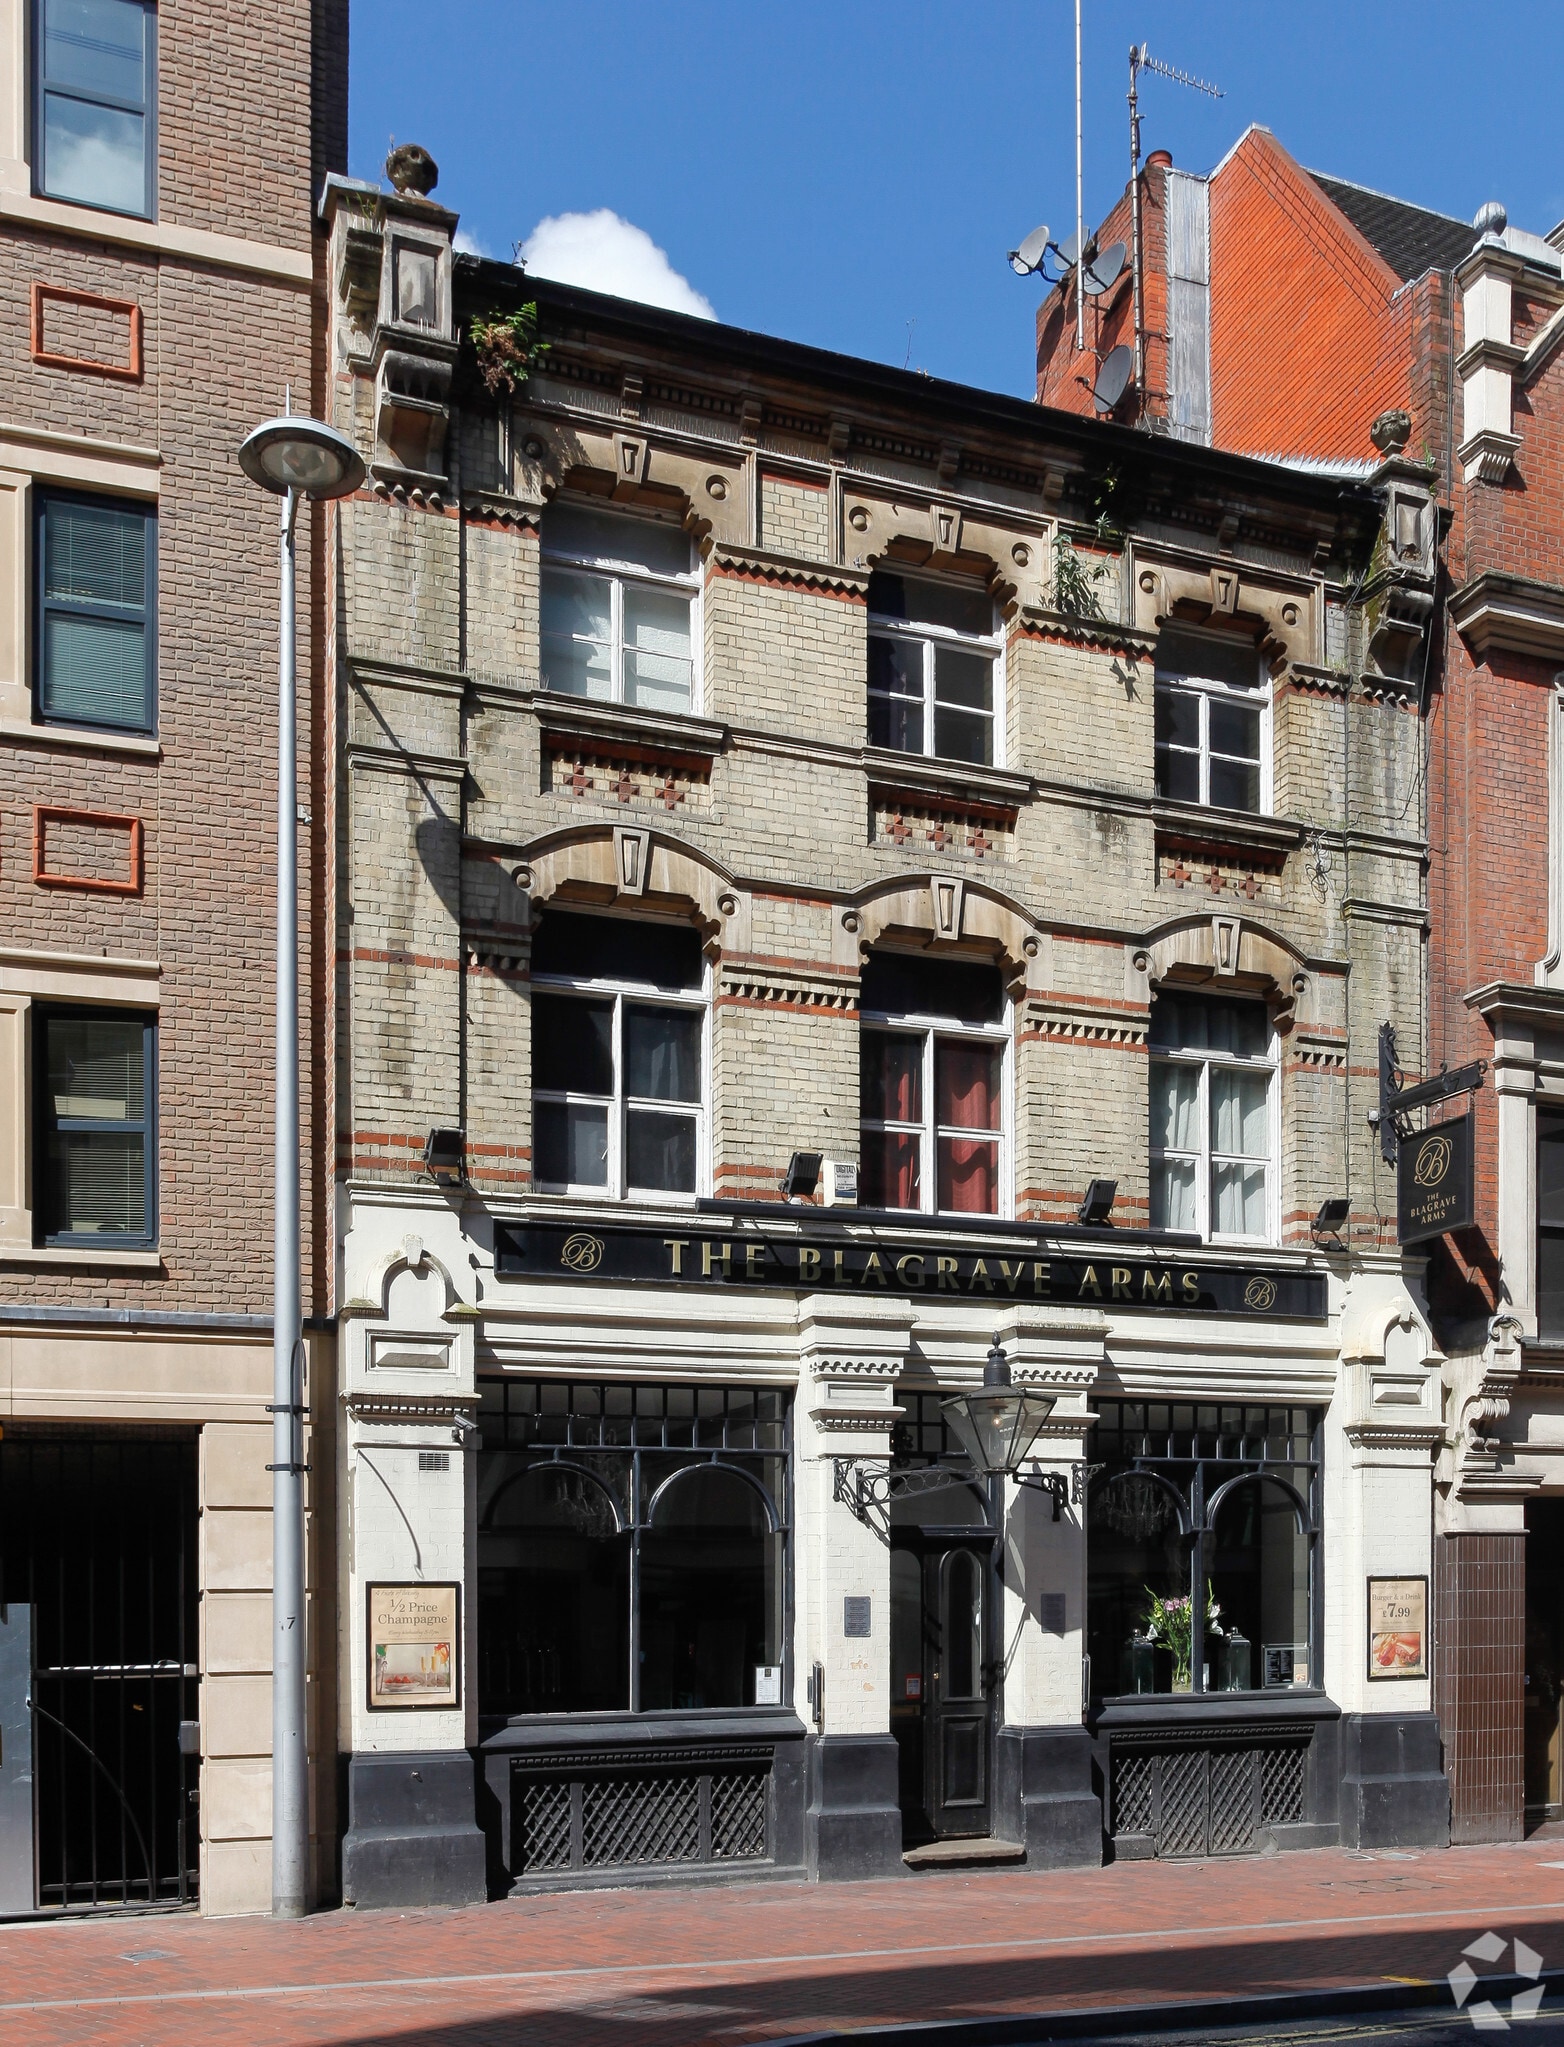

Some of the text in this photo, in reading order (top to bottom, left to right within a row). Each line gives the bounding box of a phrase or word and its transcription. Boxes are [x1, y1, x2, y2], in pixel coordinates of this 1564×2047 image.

[1426, 1192, 1440, 1202] THE
[1410, 1195, 1457, 1218] BLAGRAVE
[1421, 1209, 1446, 1225] ARMS
[663, 1239, 1201, 1303] THE BLAGRAVE ARMS
[409, 1602, 438, 1613] Price
[1382, 1603, 1410, 1617] £7.99
[286, 1616, 296, 1630] 7
